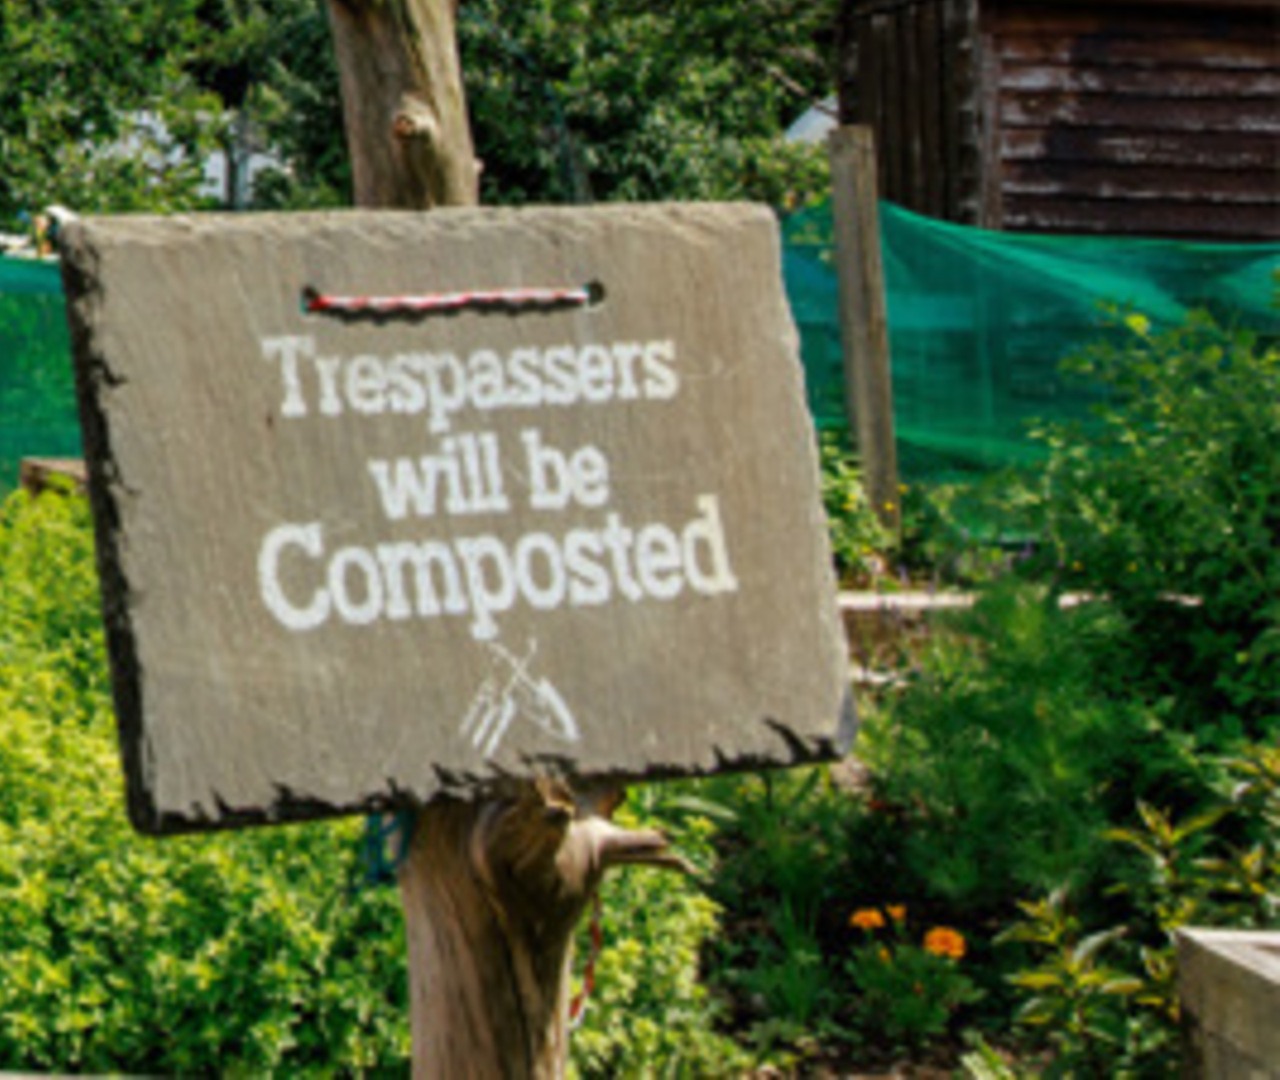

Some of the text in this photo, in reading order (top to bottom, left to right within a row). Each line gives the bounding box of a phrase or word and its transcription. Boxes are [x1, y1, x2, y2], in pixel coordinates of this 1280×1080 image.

[262, 335, 679, 432] Trespassers
[368, 429, 609, 519] will be
[258, 494, 737, 640] Composted
